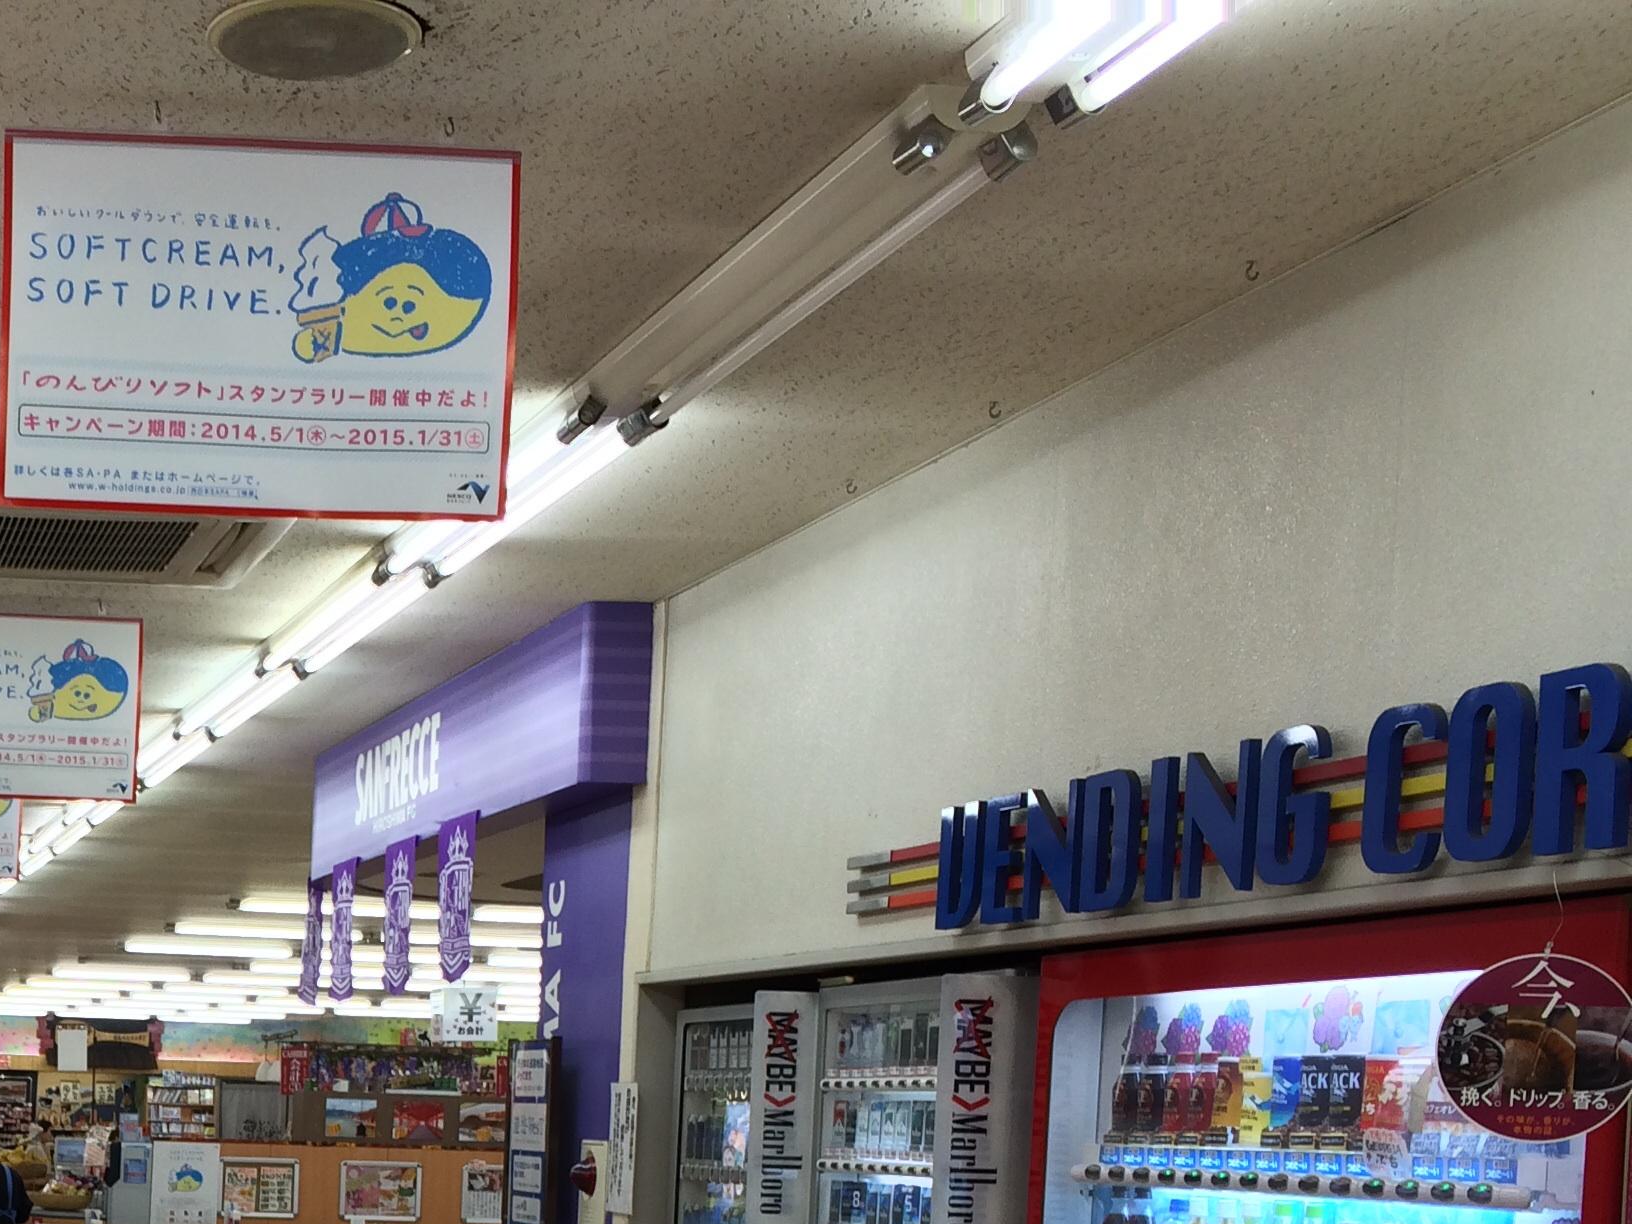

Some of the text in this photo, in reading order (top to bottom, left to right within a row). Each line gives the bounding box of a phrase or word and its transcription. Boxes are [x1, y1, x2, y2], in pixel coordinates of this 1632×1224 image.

[28, 231, 287, 275] SOFTCREAM,
[27, 277, 283, 316] SOFT DRIVE.
[354, 711, 442, 826] SANFRECCE
[935, 723, 1331, 930] VENDING
[547, 879, 566, 948] FC
[457, 1026, 485, 1037] お会計
[759, 1108, 804, 1216] Marlboro
